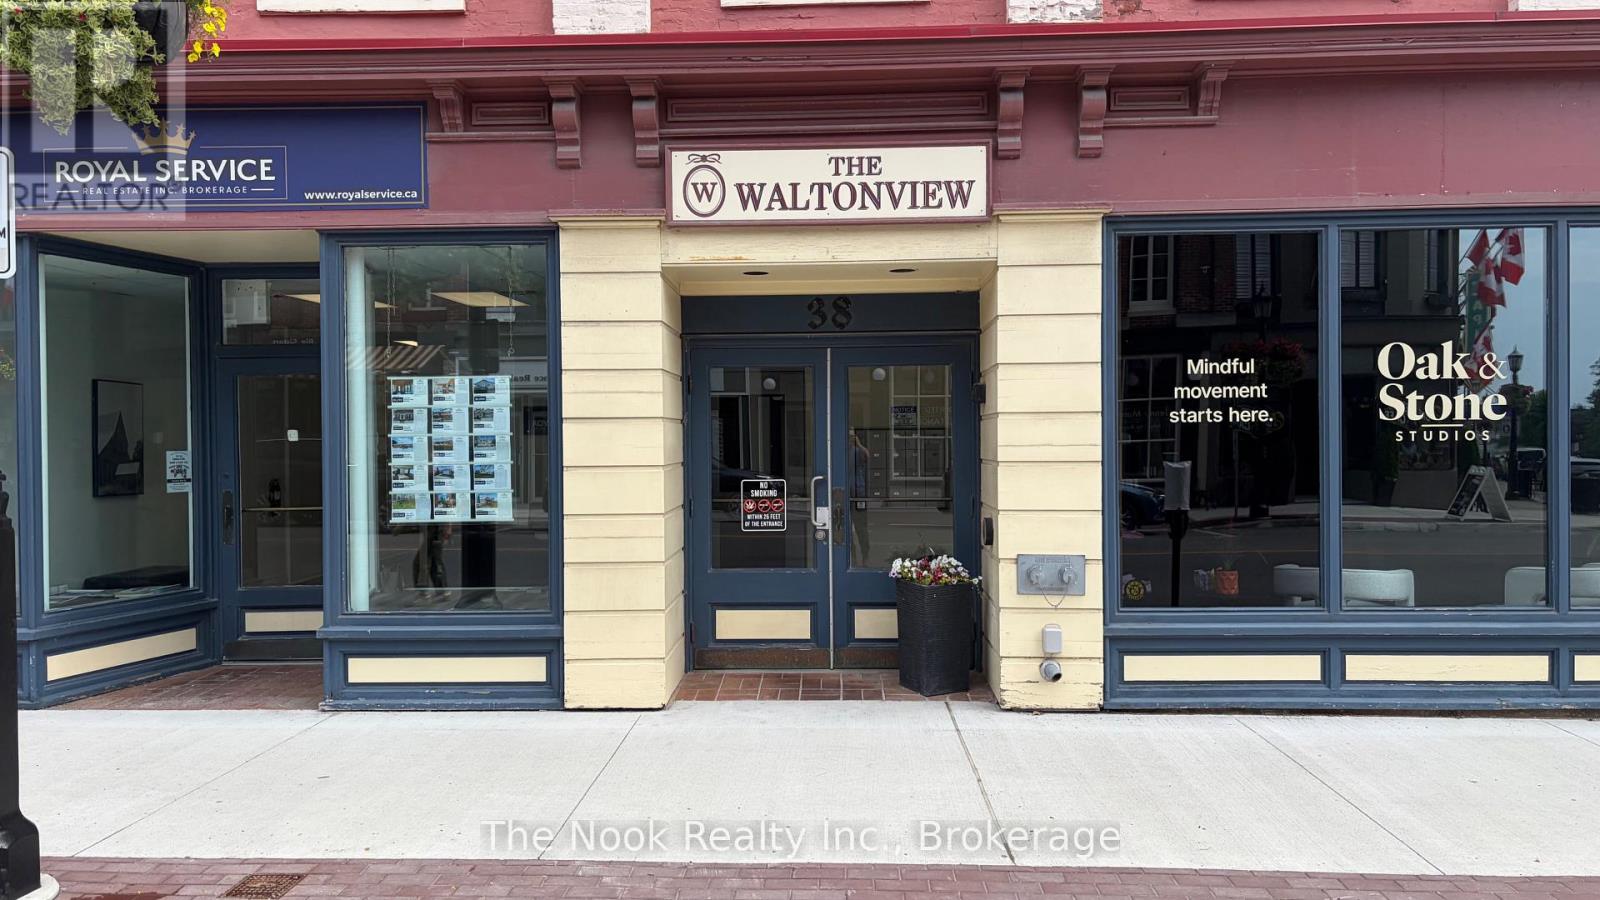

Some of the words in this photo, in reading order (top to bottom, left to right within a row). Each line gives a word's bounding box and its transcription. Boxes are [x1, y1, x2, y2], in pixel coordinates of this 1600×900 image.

[55, 160, 147, 183] ROYAL
[155, 158, 276, 183] SERVICE
[828, 155, 882, 177] THE
[82, 187, 110, 196] REAL
[113, 186, 151, 196] ESTATE
[154, 186, 178, 196] INC.
[181, 185, 248, 195] BROKERAGE
[304, 189, 418, 201] www.royalservice.ca
[690, 181, 718, 203] W
[733, 179, 976, 212] WALTONVIEW
[806, 295, 853, 331] 38
[1186, 358, 1256, 375] Mindful
[1377, 340, 1471, 380] Oak
[1477, 351, 1508, 380] &
[1173, 383, 1268, 399] movement
[1378, 383, 1508, 421] Stone
[1168, 407, 1224, 424] starts
[1228, 406, 1274, 423] here.
[1394, 430, 1492, 443] STUDIOS
[750, 489, 778, 497] SMOKING
[759, 481, 769, 489] NO
